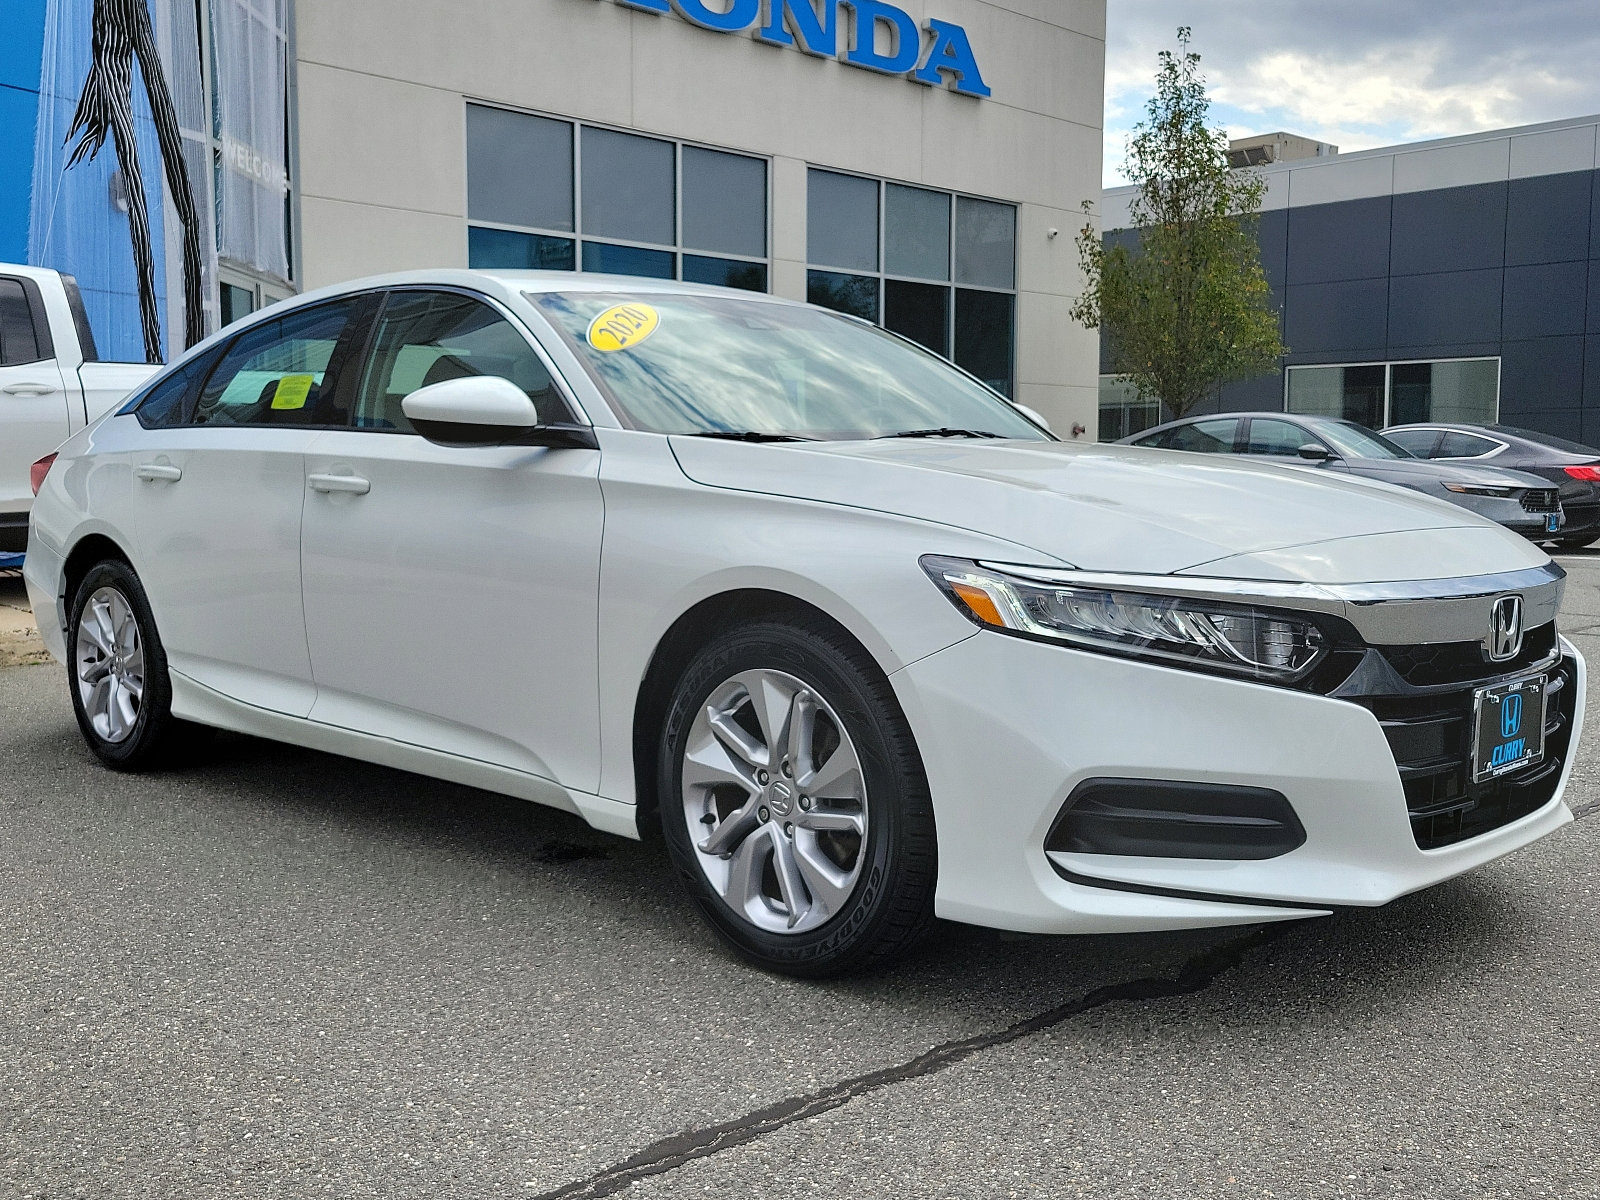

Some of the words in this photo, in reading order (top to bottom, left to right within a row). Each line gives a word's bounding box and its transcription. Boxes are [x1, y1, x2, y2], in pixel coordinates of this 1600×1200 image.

[614, 0, 991, 98] ONDA
[599, 306, 648, 345] 2020
[1491, 737, 1526, 767] CURRY
